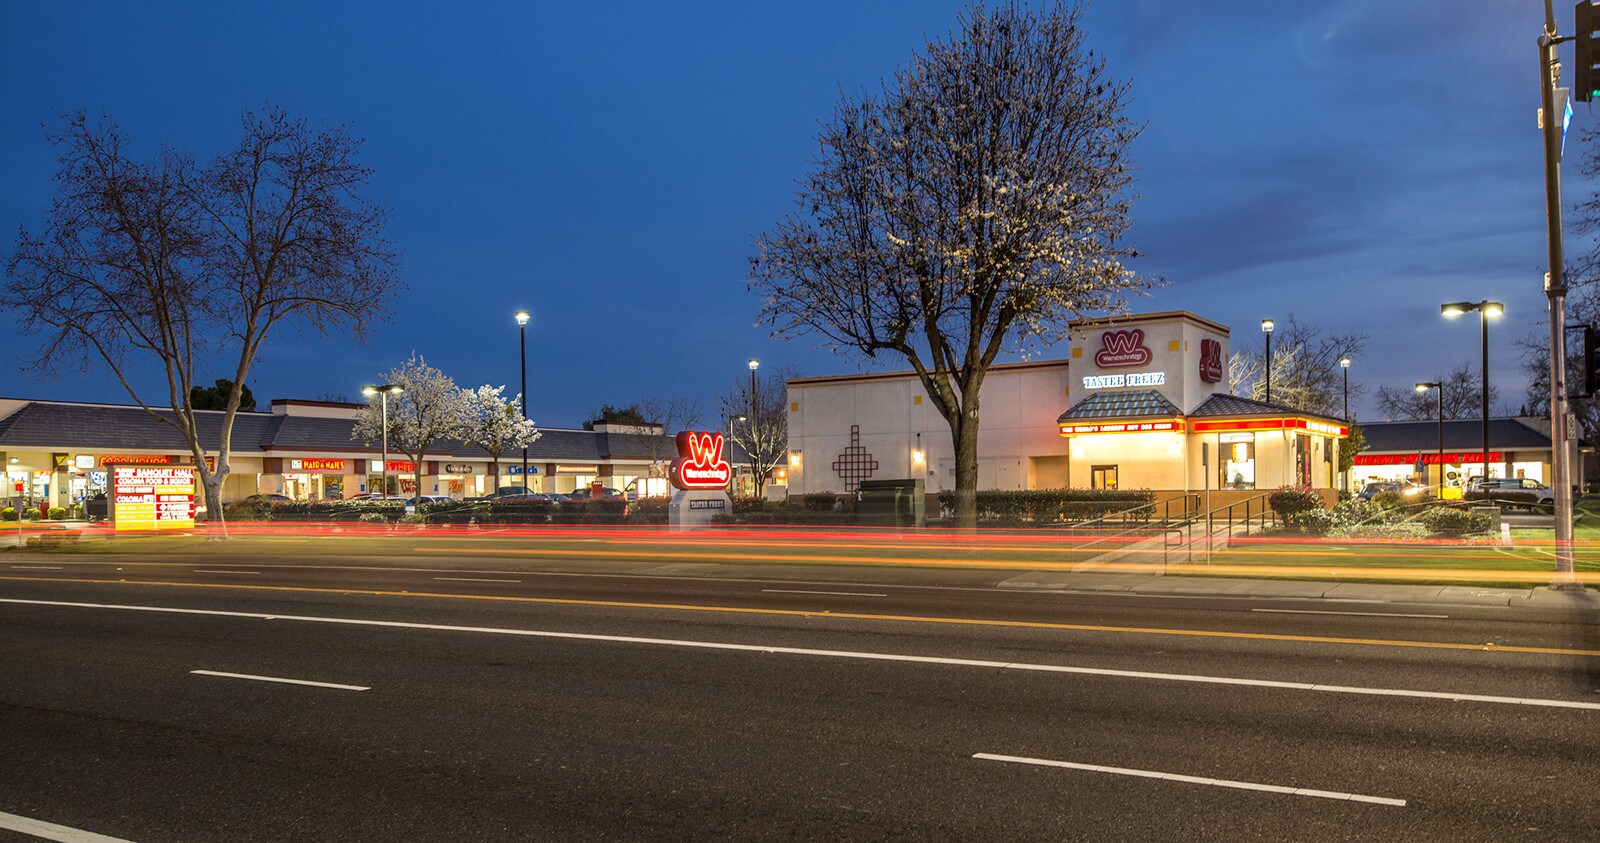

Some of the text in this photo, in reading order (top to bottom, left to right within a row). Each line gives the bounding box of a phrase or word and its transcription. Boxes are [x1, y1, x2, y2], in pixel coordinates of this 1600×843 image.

[1083, 372, 1165, 388] TASTEE FREEZ
[1354, 452, 1458, 466] SHERWIN-WILIAMS
[303, 461, 320, 469] HAIR
[325, 461, 345, 470] NAILS
[508, 465, 538, 475] Chuch
